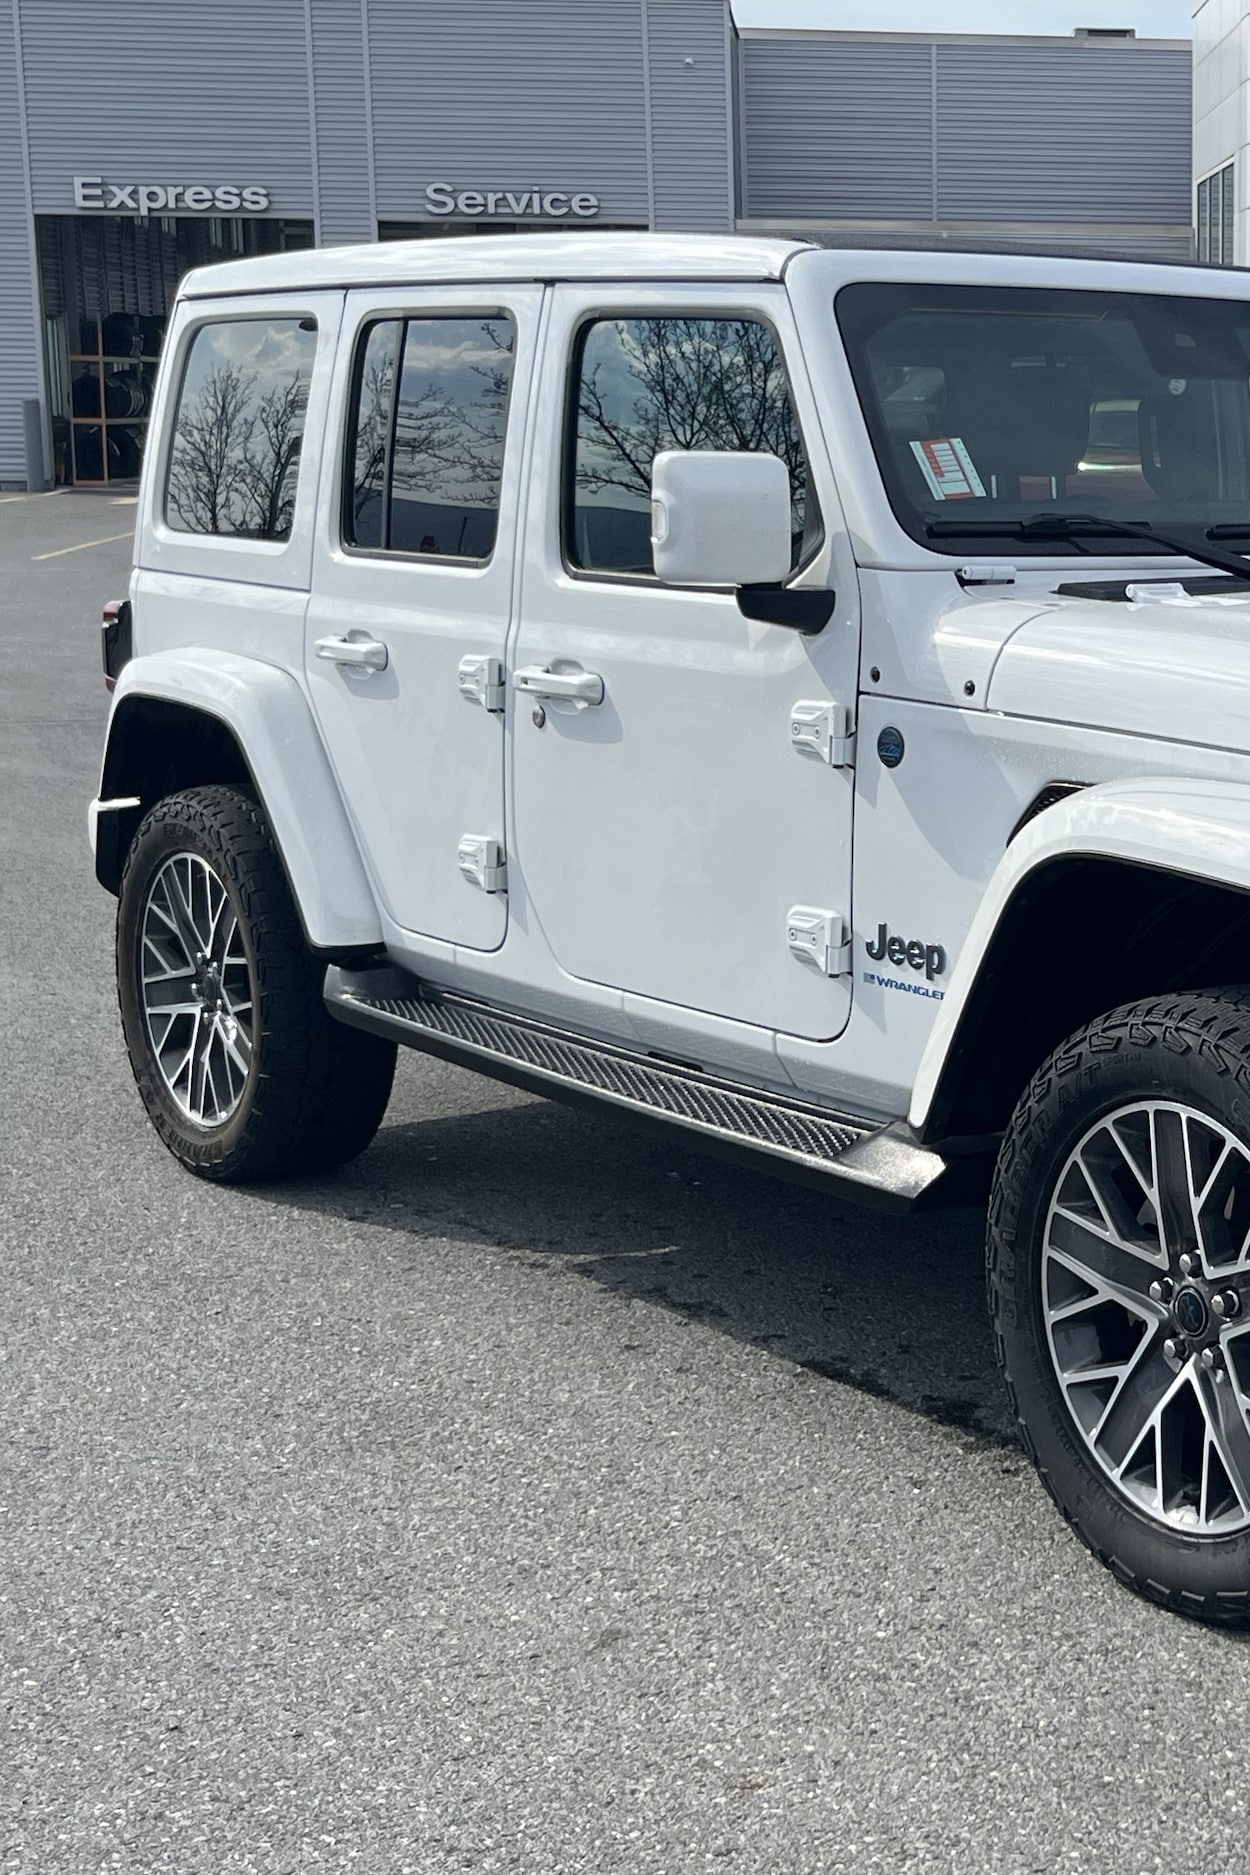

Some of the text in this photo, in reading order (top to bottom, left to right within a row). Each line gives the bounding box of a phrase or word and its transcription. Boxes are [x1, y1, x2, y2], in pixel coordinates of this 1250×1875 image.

[72, 176, 270, 215] Express
[425, 182, 601, 217] Service
[865, 921, 947, 981] Jeep
